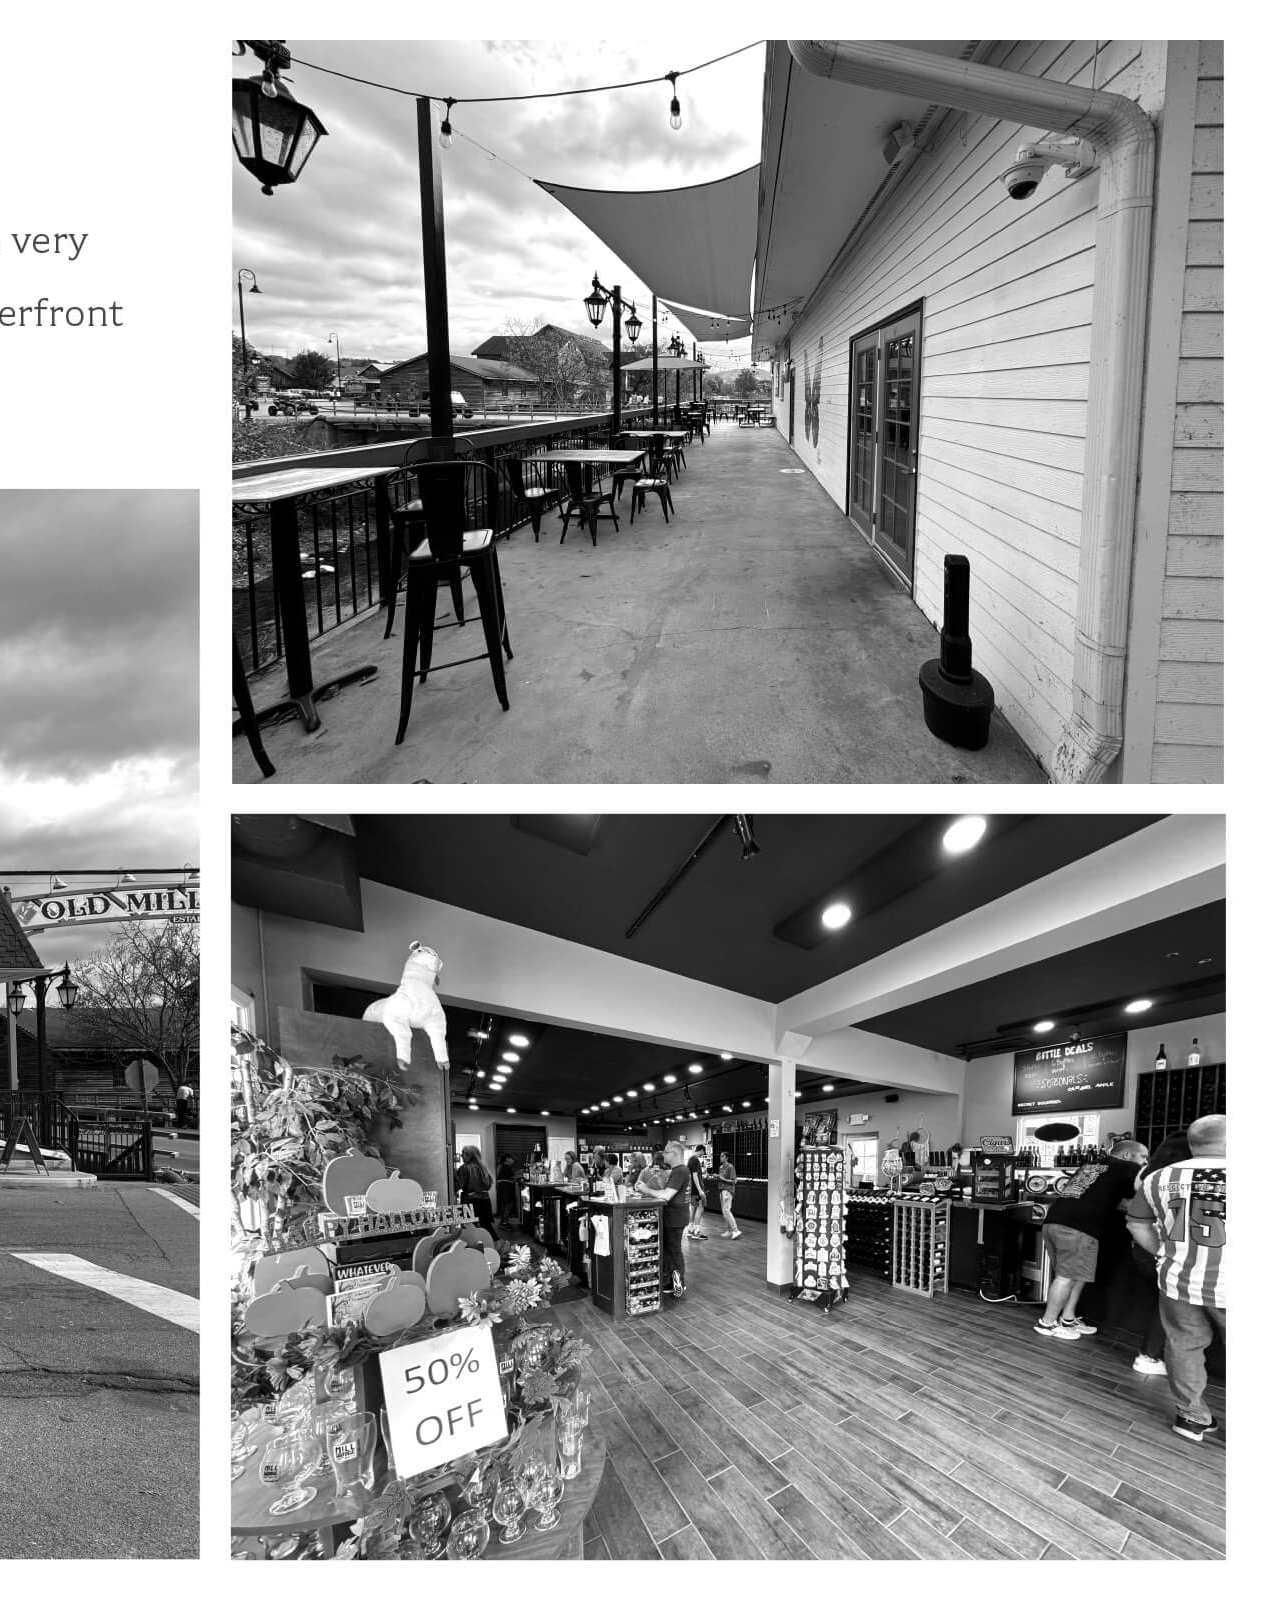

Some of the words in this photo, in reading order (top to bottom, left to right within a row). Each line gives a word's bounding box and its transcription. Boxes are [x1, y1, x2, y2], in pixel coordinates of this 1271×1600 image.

[41, 896, 111, 920] OLD
[1065, 1042, 1094, 1056] DEALS
[405, 1347, 479, 1394] 50%
[416, 1398, 483, 1445] OFF
